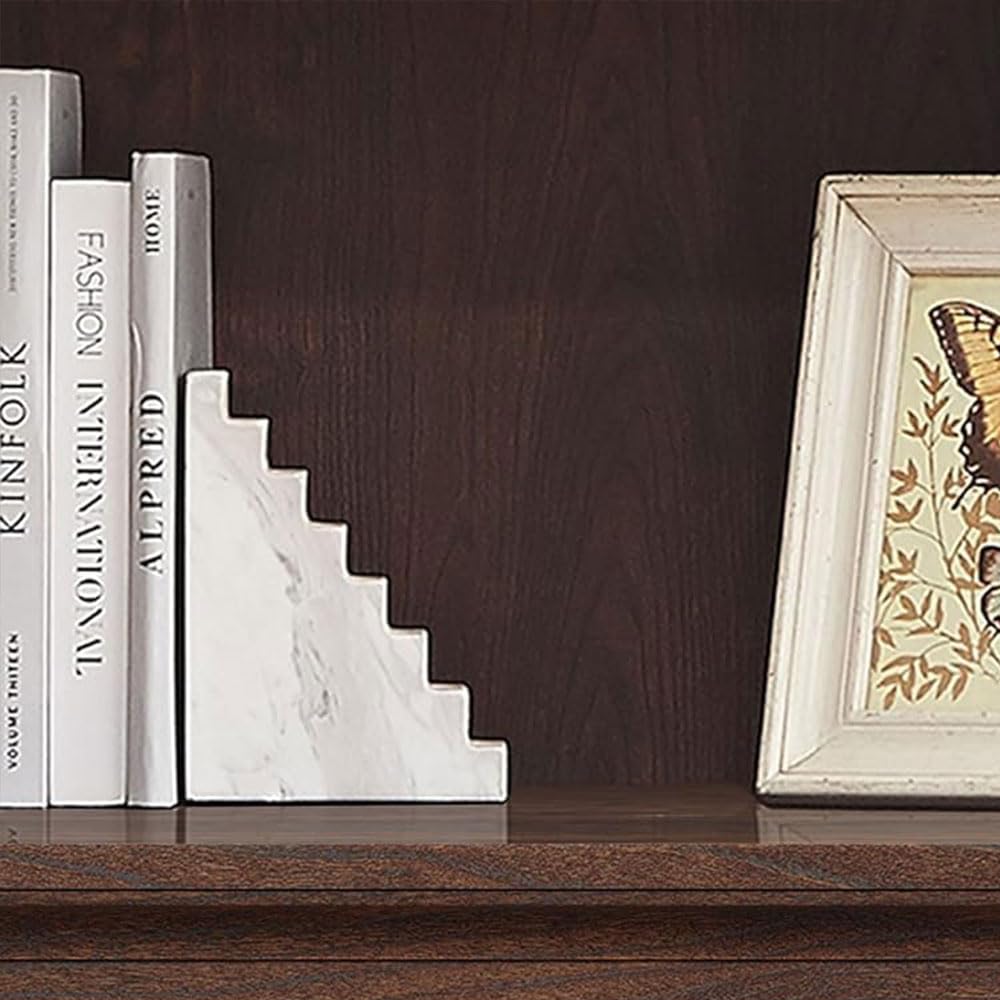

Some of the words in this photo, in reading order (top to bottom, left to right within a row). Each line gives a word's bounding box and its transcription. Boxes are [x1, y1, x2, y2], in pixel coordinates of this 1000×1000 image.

[76, 232, 105, 356] FASHION
[145, 188, 161, 253] HOME
[0, 343, 27, 534] KINFOLK
[139, 394, 164, 575] ALPRED
[75, 383, 104, 676] INTERNATIONAL
[7, 705, 19, 769] VOLUME
